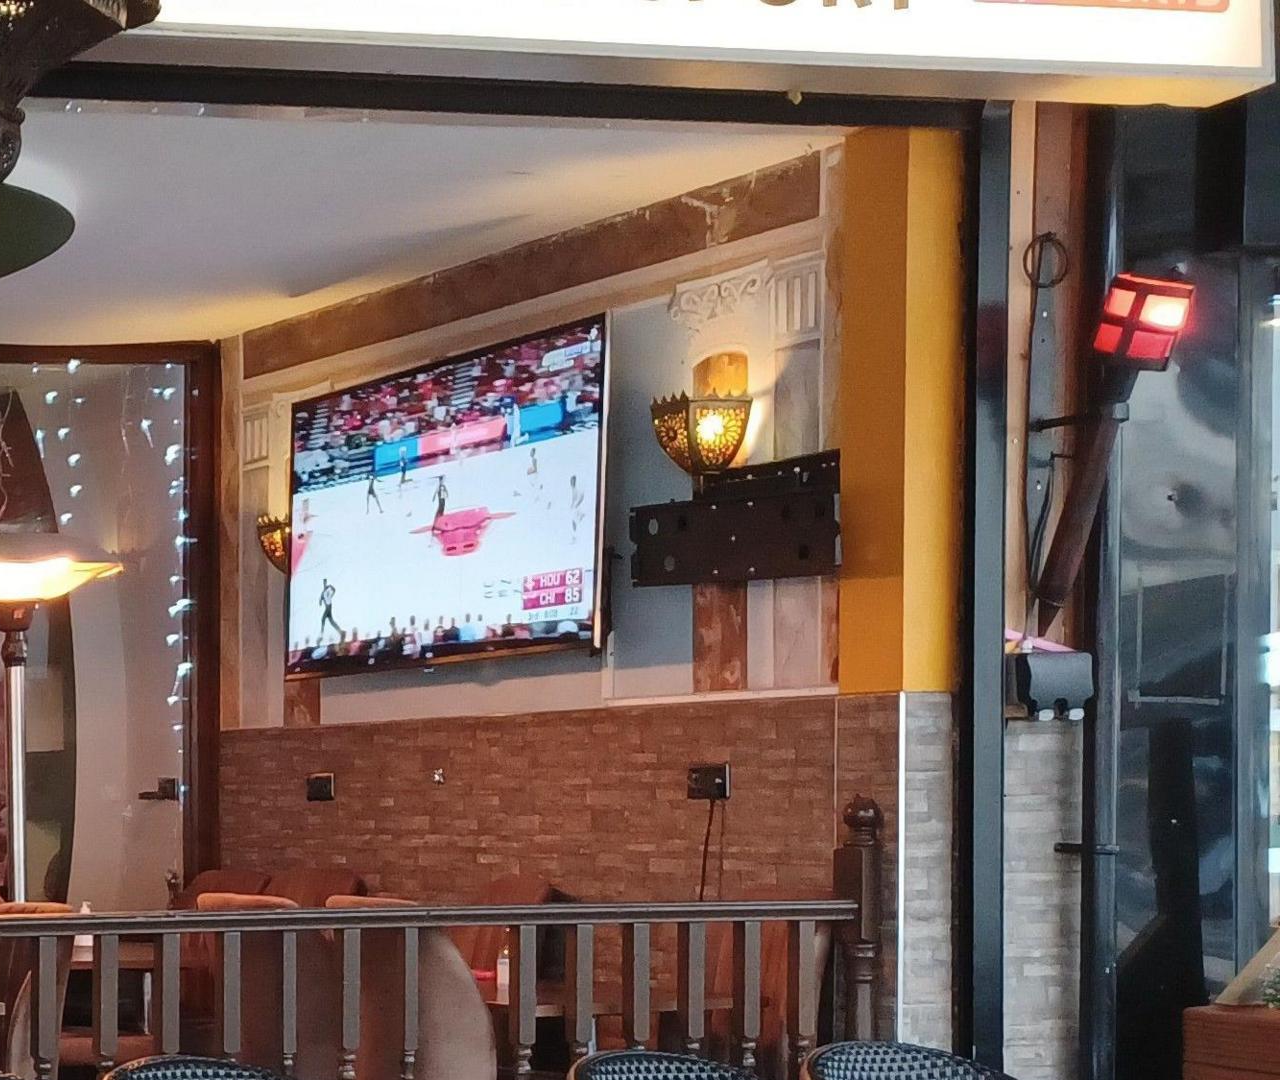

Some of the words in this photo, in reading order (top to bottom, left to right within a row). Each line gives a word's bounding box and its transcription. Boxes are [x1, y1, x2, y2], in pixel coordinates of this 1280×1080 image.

[540, 573, 560, 588] HOU
[565, 569, 580, 585] 62
[540, 591, 556, 606] CHI
[565, 587, 580, 603] 85
